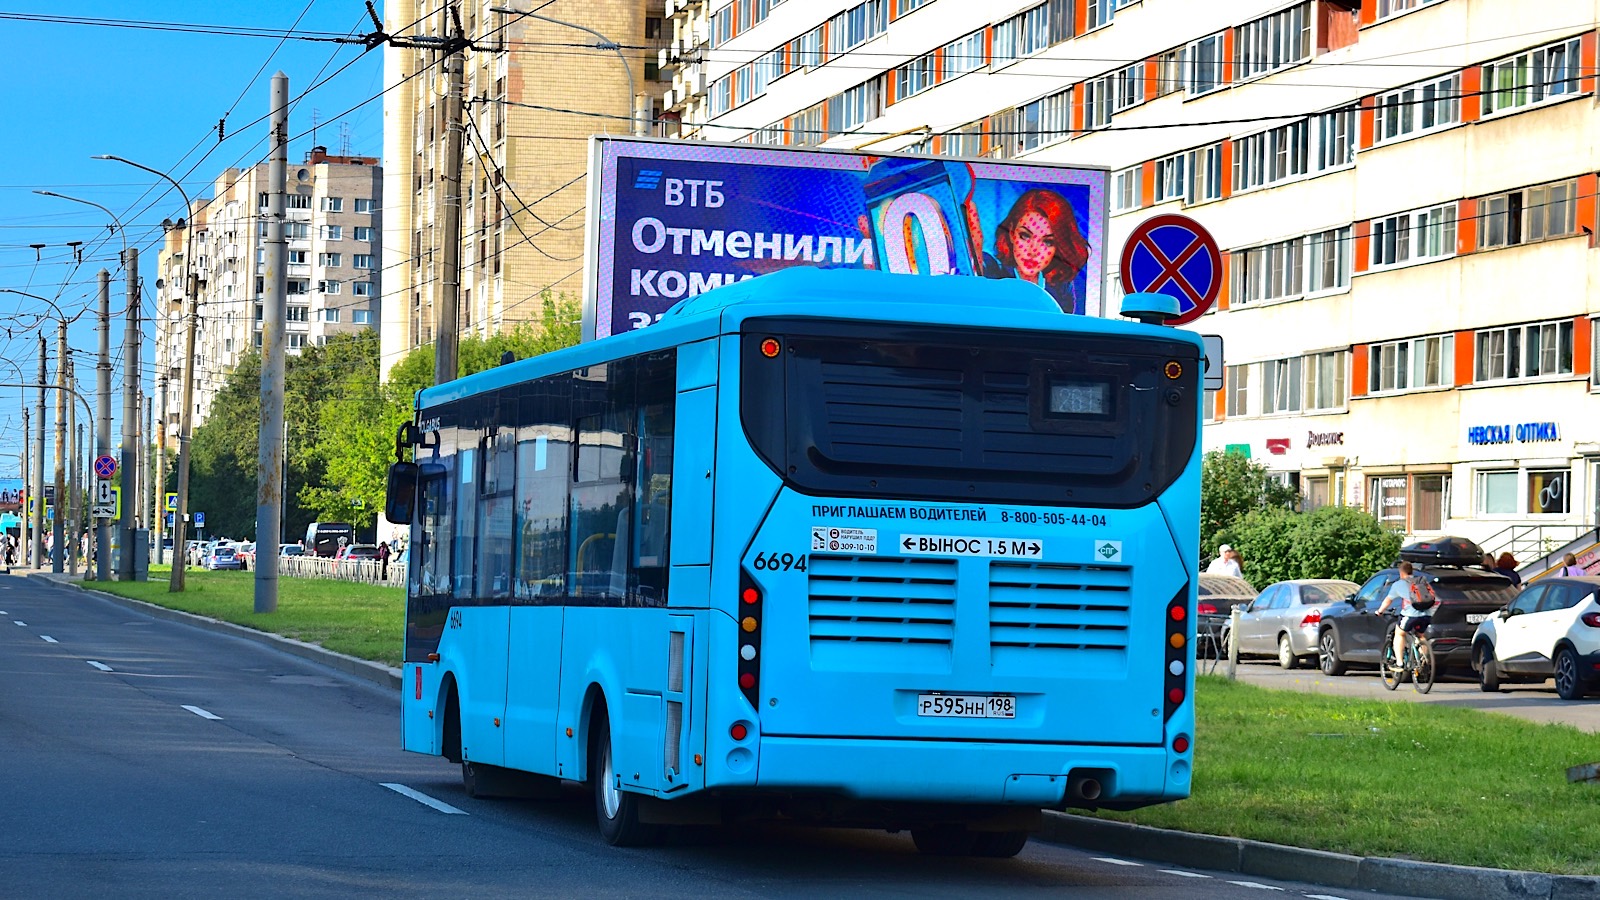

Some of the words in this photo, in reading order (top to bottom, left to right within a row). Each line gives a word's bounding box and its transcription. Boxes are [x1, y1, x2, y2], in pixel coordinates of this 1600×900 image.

[664, 178, 725, 209] ВТБ
[631, 216, 873, 265] Отменили
[630, 268, 754, 299] ком
[1468, 424, 1511, 444] НЕВСКАЯ
[1516, 421, 1558, 442] ОПТИКА
[812, 504, 906, 519] ПРИГЛАШАЕМ
[910, 507, 987, 521] ВОДИТЕЛЕЙ
[1001, 510, 1107, 527] 8-800-505-44-04
[840, 543, 875, 551] 309-10-10
[919, 537, 981, 553] ВЫНОС
[987, 540, 1007, 555] 1.5
[1012, 541, 1026, 556] М
[1100, 547, 1115, 555] СПГ
[753, 551, 807, 573] 6694
[450, 610, 462, 630] 6694
[922, 697, 985, 715] Р595НН
[988, 698, 1011, 711] 198
